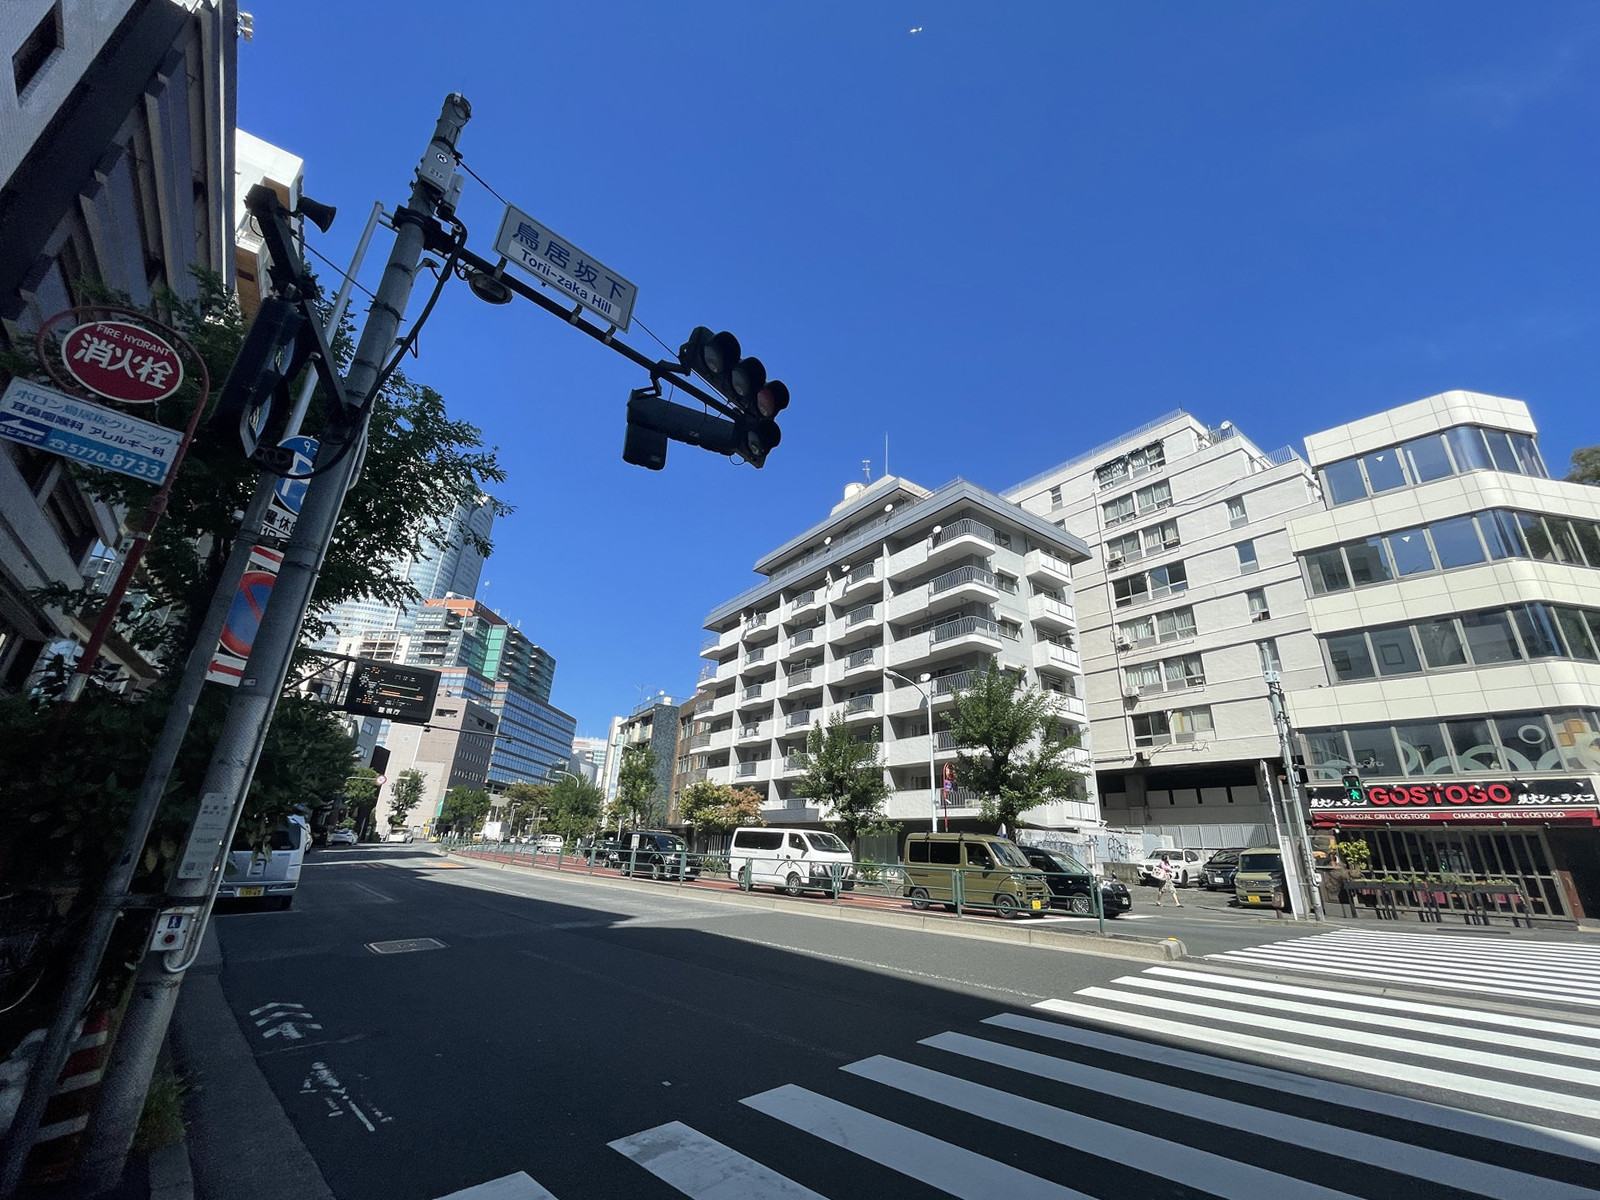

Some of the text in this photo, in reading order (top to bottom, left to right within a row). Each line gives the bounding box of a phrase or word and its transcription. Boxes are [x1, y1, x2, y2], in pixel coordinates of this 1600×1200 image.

[511, 221, 626, 300] 鳥居坂下
[521, 249, 612, 315] Torii-zaka Hill
[73, 333, 174, 389] 消火栓
[96, 324, 171, 356] FIRE HYDRANT
[10, 401, 84, 432] 耳鼻咽喉科
[88, 426, 166, 457] アレルギー科
[15, 389, 172, 446] ホロン鳥居坂クリニック
[67, 443, 162, 478] 5770-8733
[1368, 784, 1512, 806] GOSTOSO
[1394, 812, 1430, 820] GOSTOSO
[1517, 793, 1595, 805] 炭火シュラスコ
